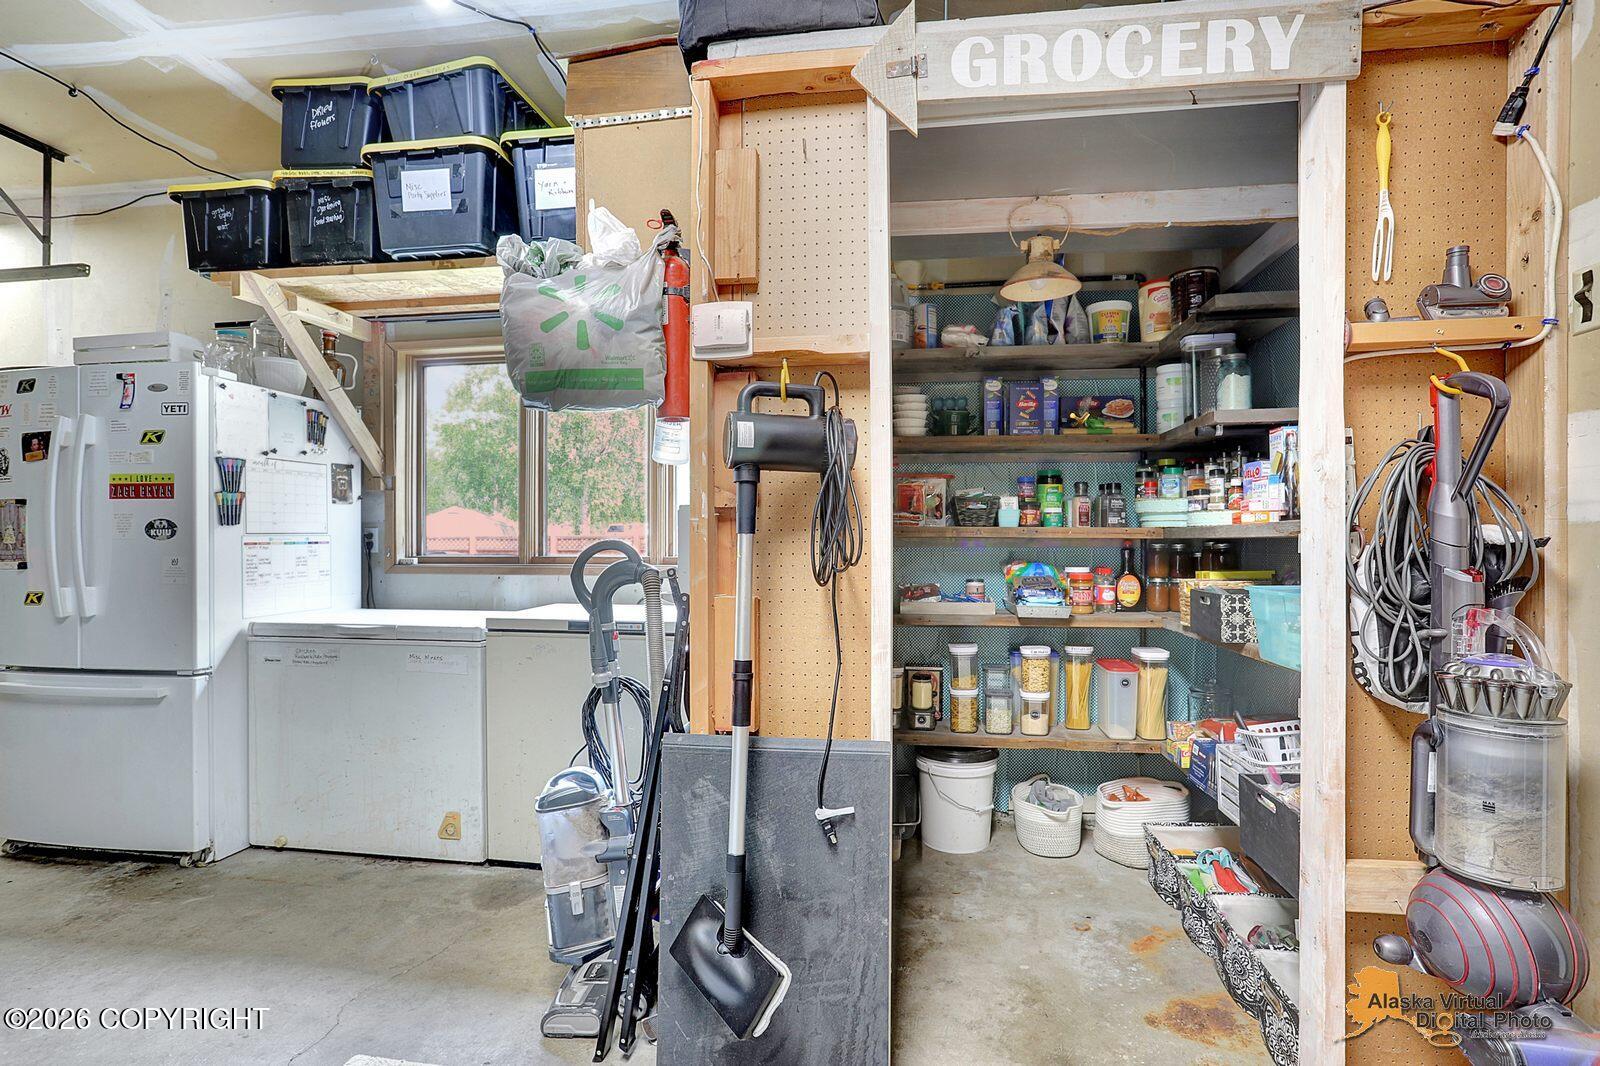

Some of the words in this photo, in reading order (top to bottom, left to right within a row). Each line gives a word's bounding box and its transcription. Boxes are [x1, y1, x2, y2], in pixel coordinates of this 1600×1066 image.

[950, 14, 1305, 89] GROCERY
[163, 404, 187, 413] YETI
[136, 474, 152, 483] LOVE
[111, 485, 136, 498] ZACH
[140, 485, 173, 498] BRYAN
[150, 528, 172, 536] KUIU
